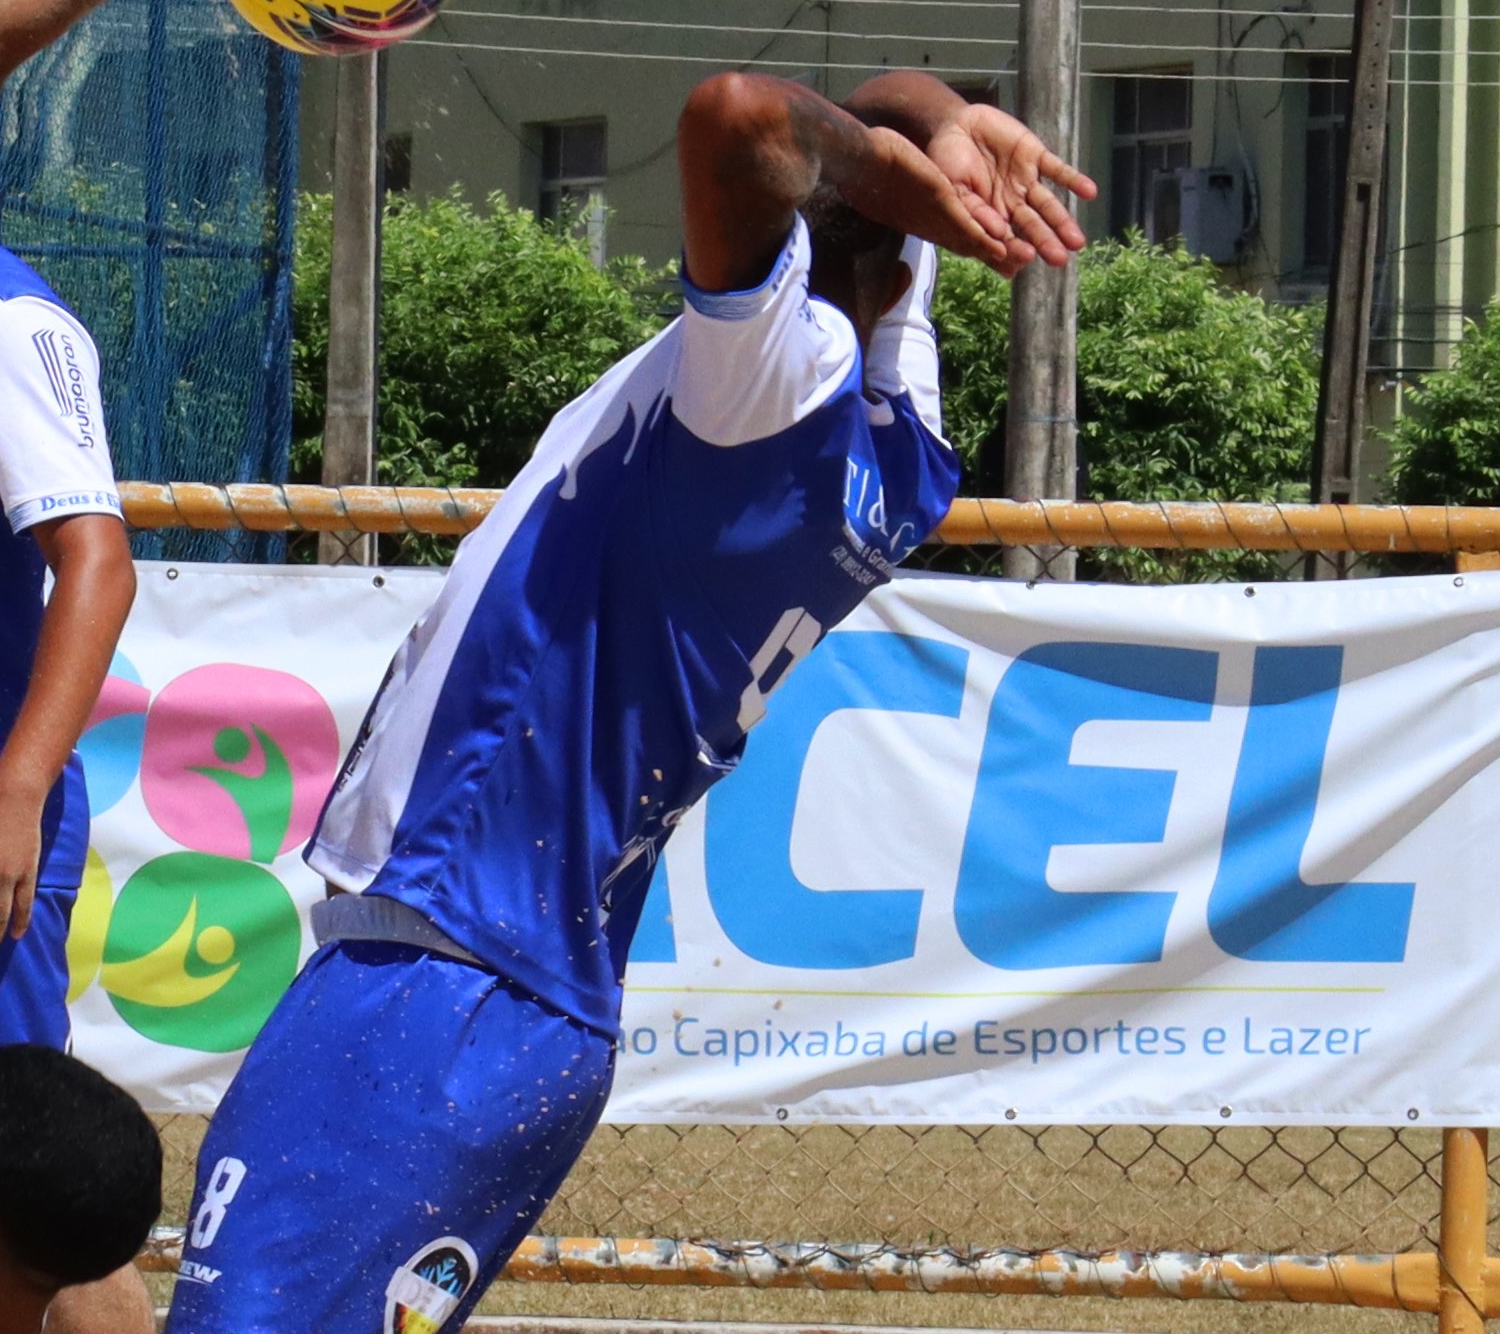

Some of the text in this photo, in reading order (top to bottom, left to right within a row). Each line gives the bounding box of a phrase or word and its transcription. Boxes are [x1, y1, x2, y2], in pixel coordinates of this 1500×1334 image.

[60, 334, 95, 450] brumagran
[41, 492, 91, 513] Deus
[628, 630, 1416, 971] CEL
[673, 1016, 887, 1067] Capixaba
[901, 1017, 957, 1057] de
[974, 1019, 1189, 1065] Esportes
[1201, 1026, 1227, 1058] e
[1242, 1017, 1372, 1058] Lazer
[189, 1155, 248, 1250] 8
